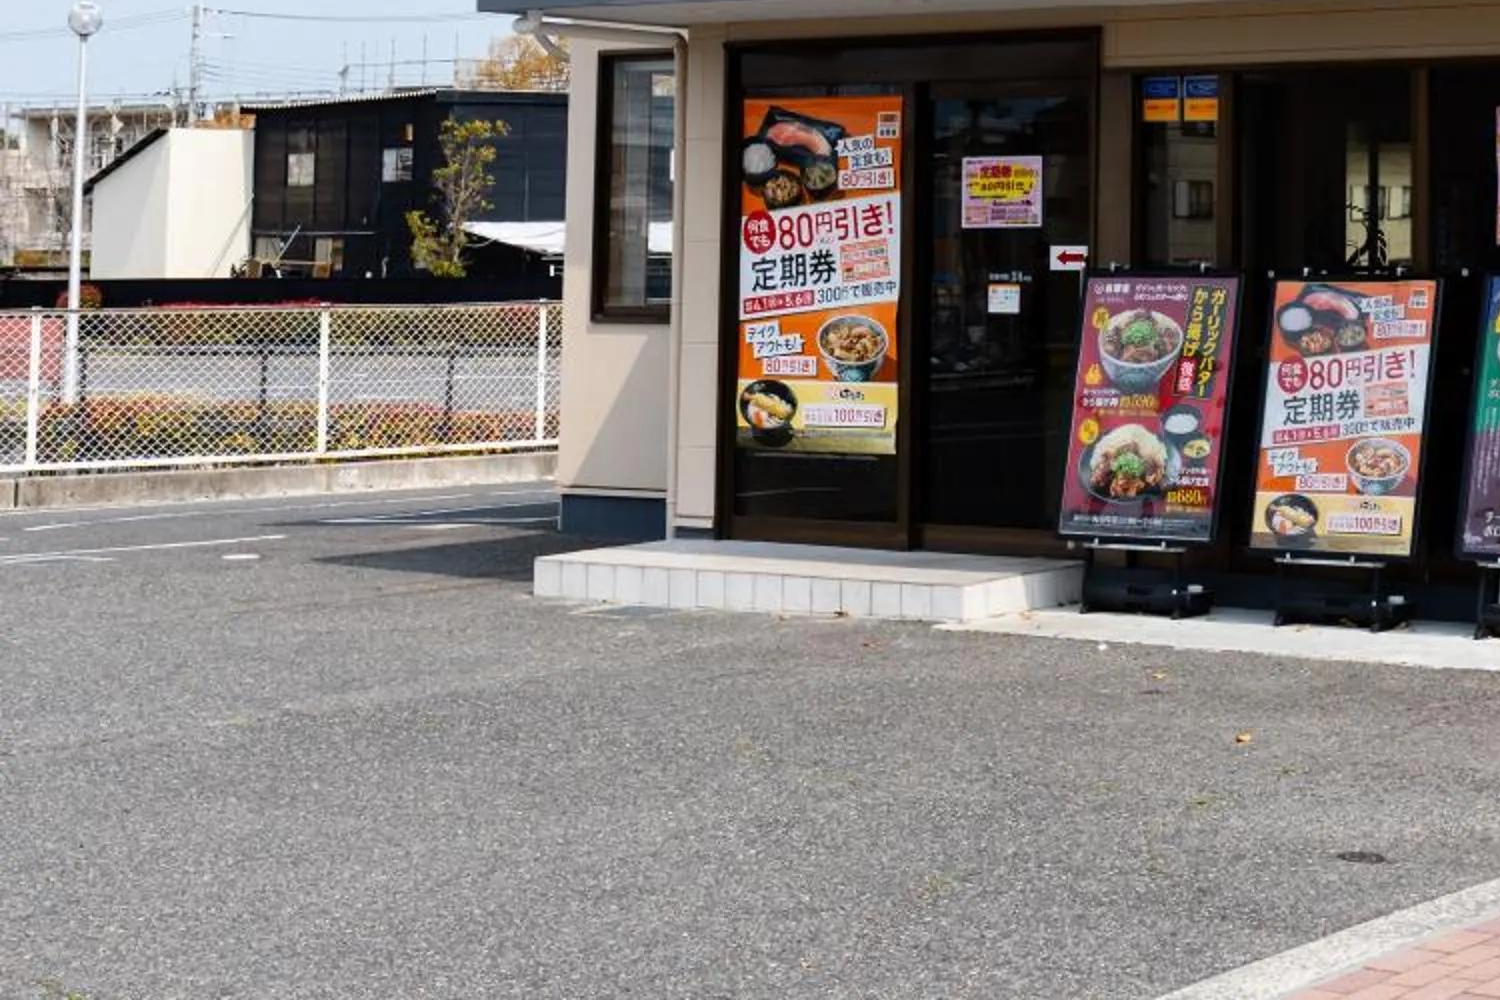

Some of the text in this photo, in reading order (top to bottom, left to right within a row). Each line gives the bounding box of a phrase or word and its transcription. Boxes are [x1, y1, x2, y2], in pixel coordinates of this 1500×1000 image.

[778, 200, 894, 251] 80円引き!
[751, 249, 837, 292] 定期券
[1309, 350, 1416, 390] 80円引き!
[1283, 388, 1360, 425] 定期券
